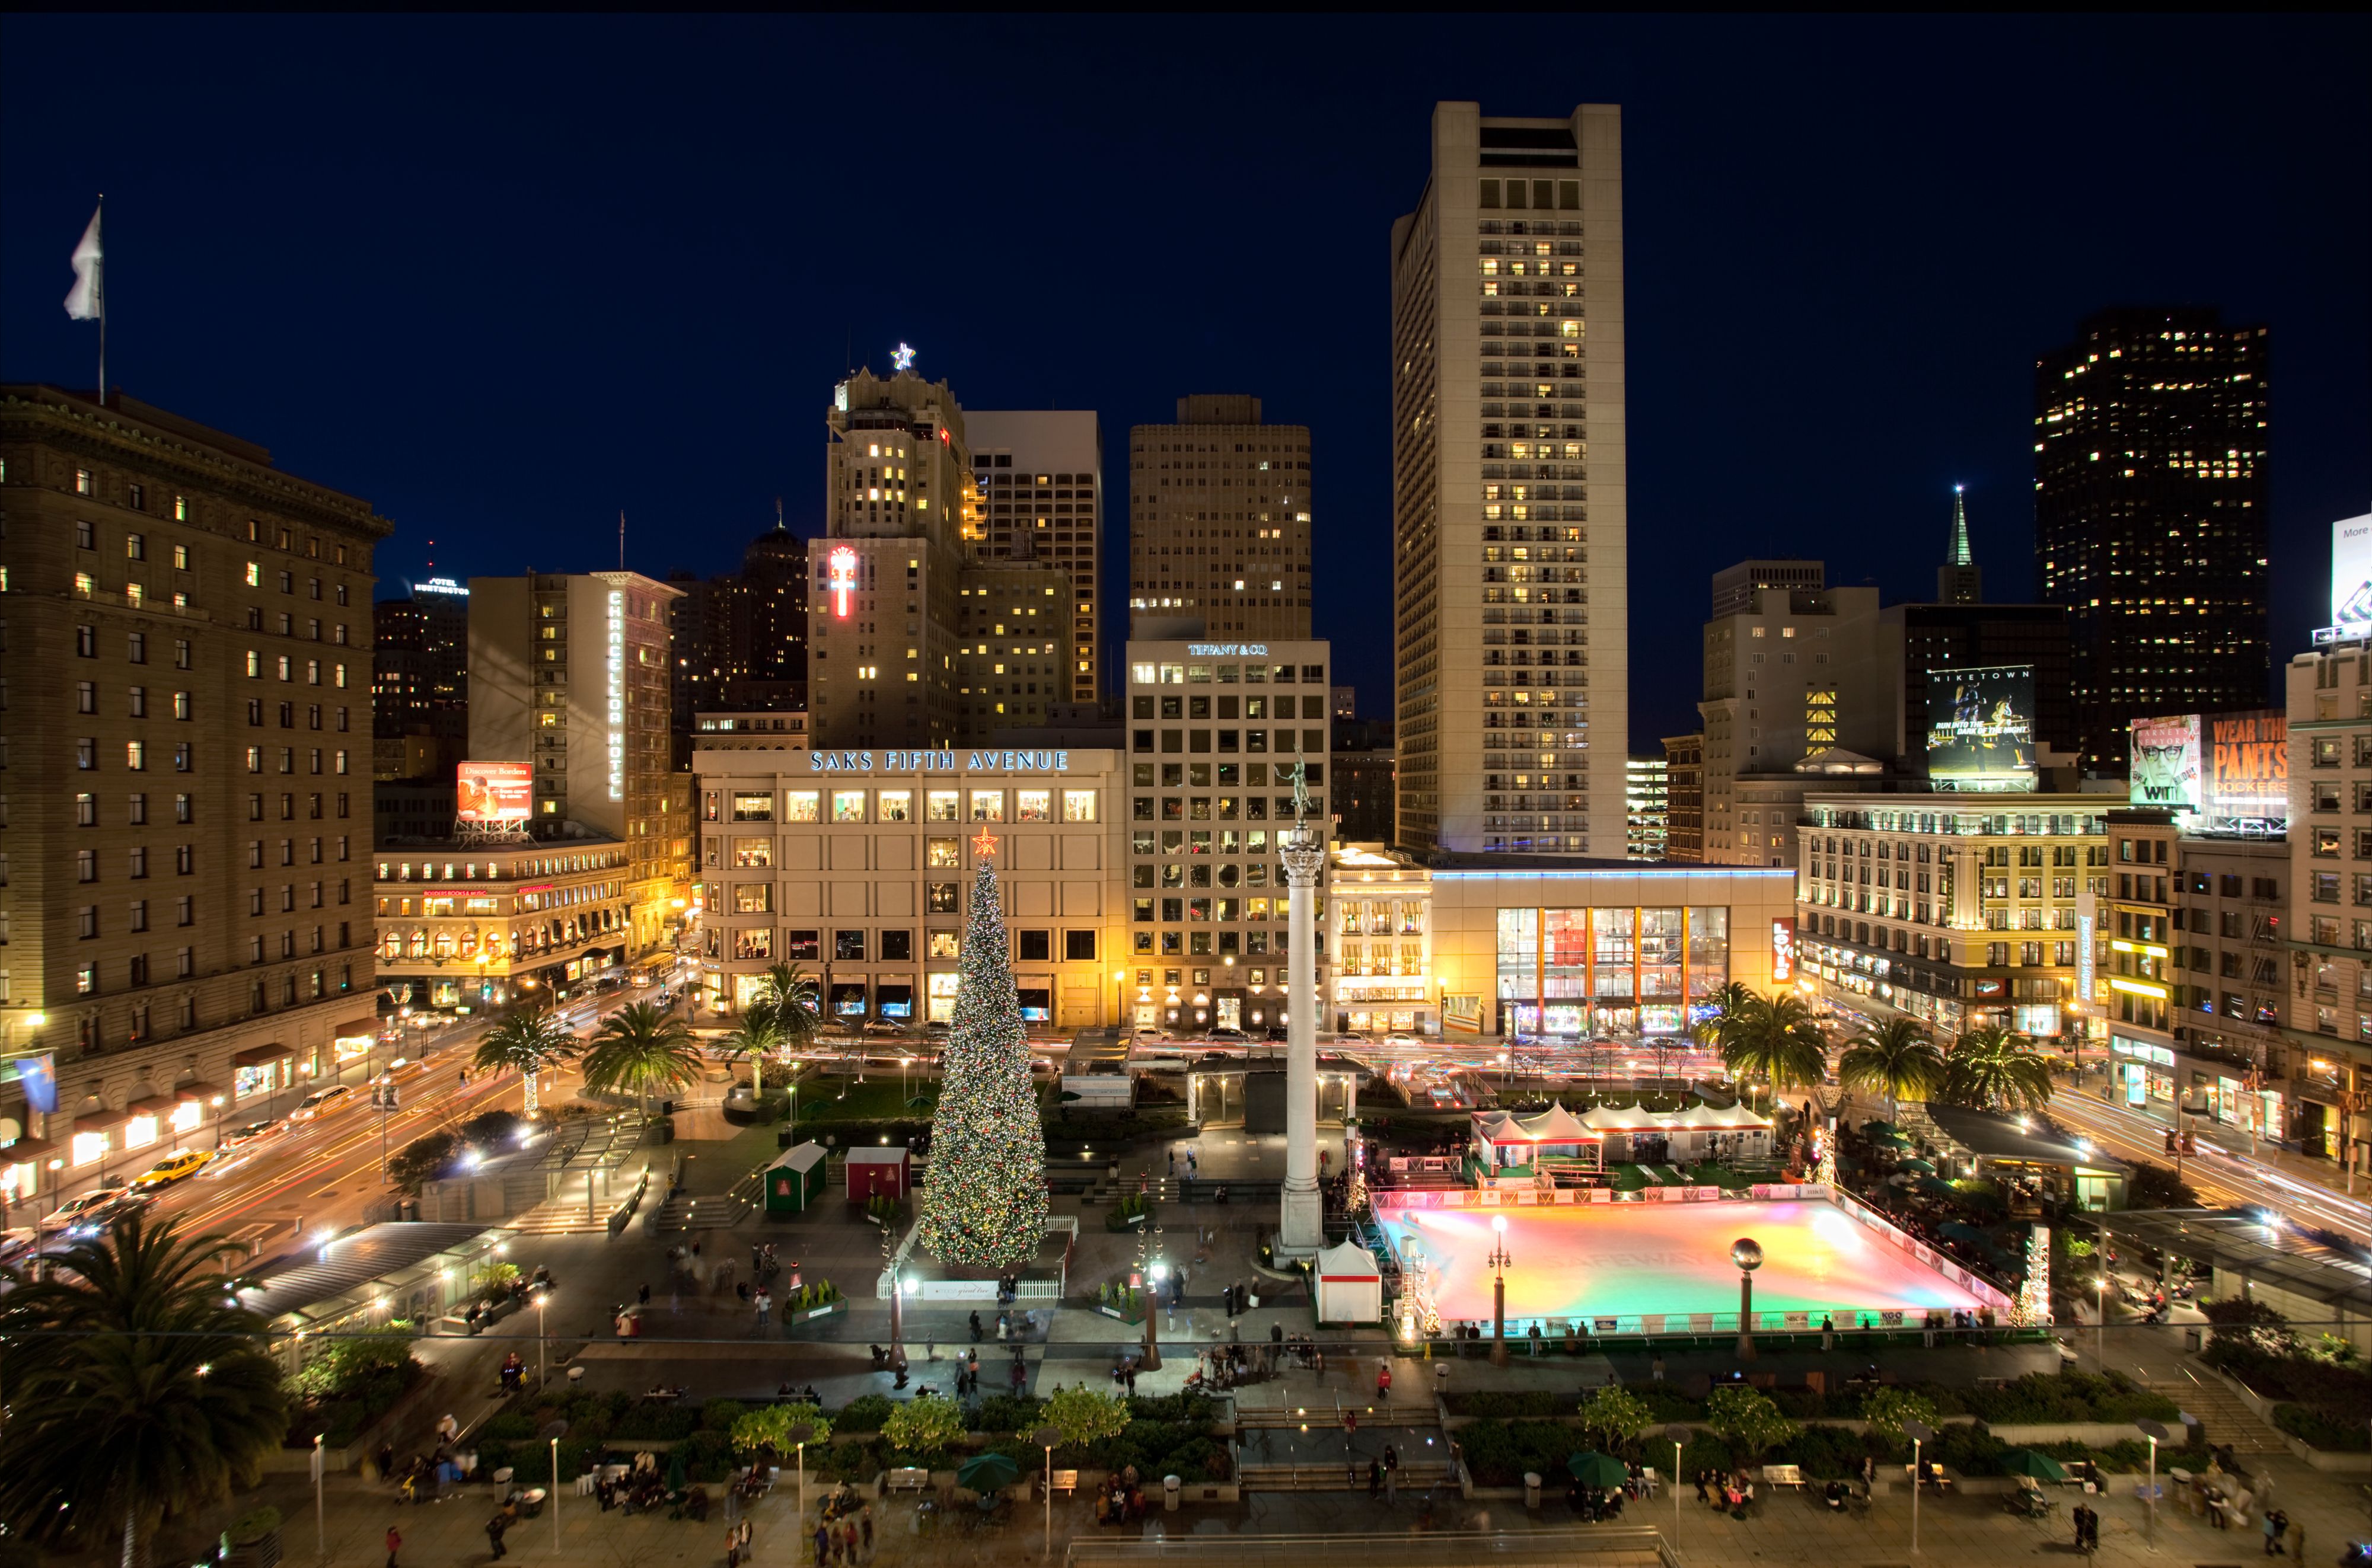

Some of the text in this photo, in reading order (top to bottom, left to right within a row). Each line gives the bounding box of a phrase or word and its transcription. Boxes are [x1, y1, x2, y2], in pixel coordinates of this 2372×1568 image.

[2344, 527, 2368, 538] More
[1188, 644, 1238, 655] TIFFANY
[1239, 644, 1248, 655] &
[1934, 672, 2029, 682] NIKETOWN
[609, 592, 622, 798] CHANCELLOR HOTEL
[2138, 729, 2189, 737] BARNEYS
[2213, 720, 2256, 743] WEAR
[811, 751, 1068, 771] SAKS FIFTH AVENUE
[2214, 742, 2288, 780] PANTS
[2144, 786, 2178, 800] WITTY
[2214, 781, 2288, 793] DOCKERS
